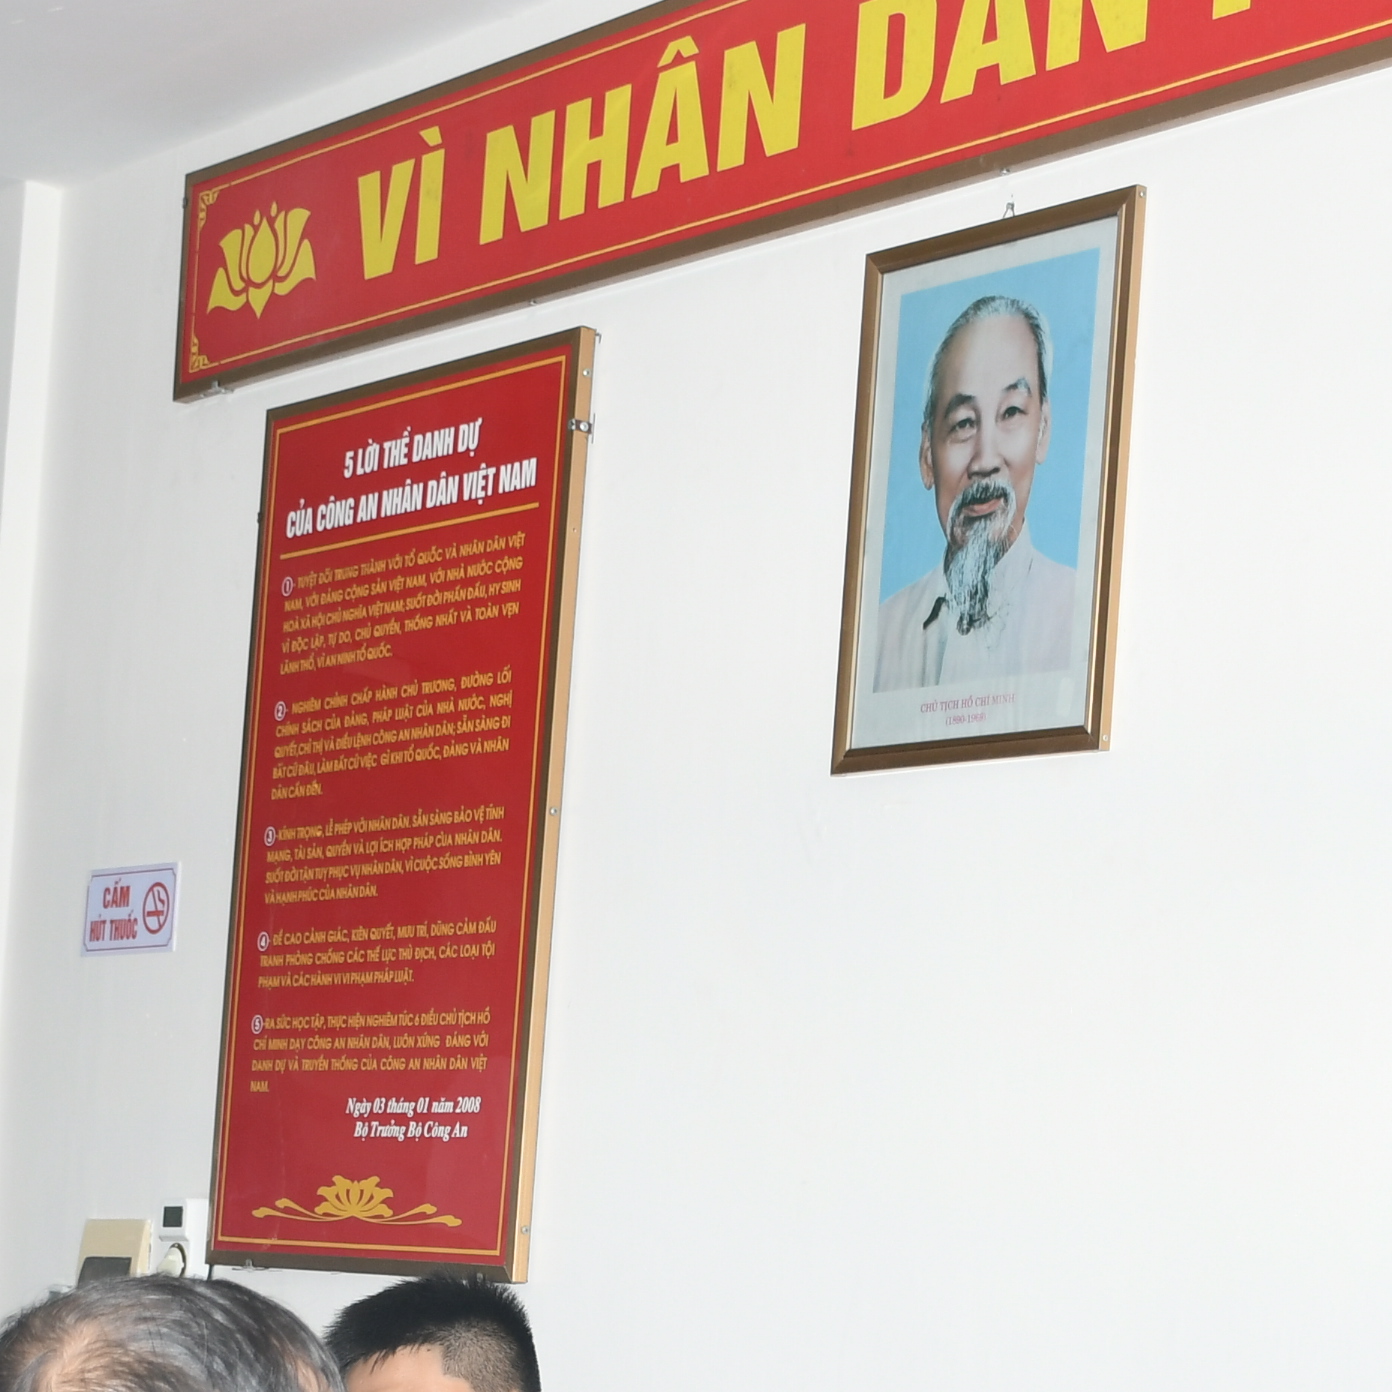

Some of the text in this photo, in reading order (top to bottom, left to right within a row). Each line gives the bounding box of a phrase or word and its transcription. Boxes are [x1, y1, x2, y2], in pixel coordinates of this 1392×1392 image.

[358, 126, 445, 280] VÌ
[479, 23, 806, 245] NHÂN
[343, 416, 483, 479] 5 LỜI THỀ DANH DỰ
[285, 456, 538, 539] CỦA CÔNG AN NHÂN DÂN VIỆT NAM
[103, 878, 131, 910] CẤM
[89, 909, 138, 942] HÚT THUỐC
[345, 1096, 482, 1118] Ngày 03 tháng 01 năm 2008
[353, 1119, 469, 1142] Bộ Trưởng Bộ Công An
